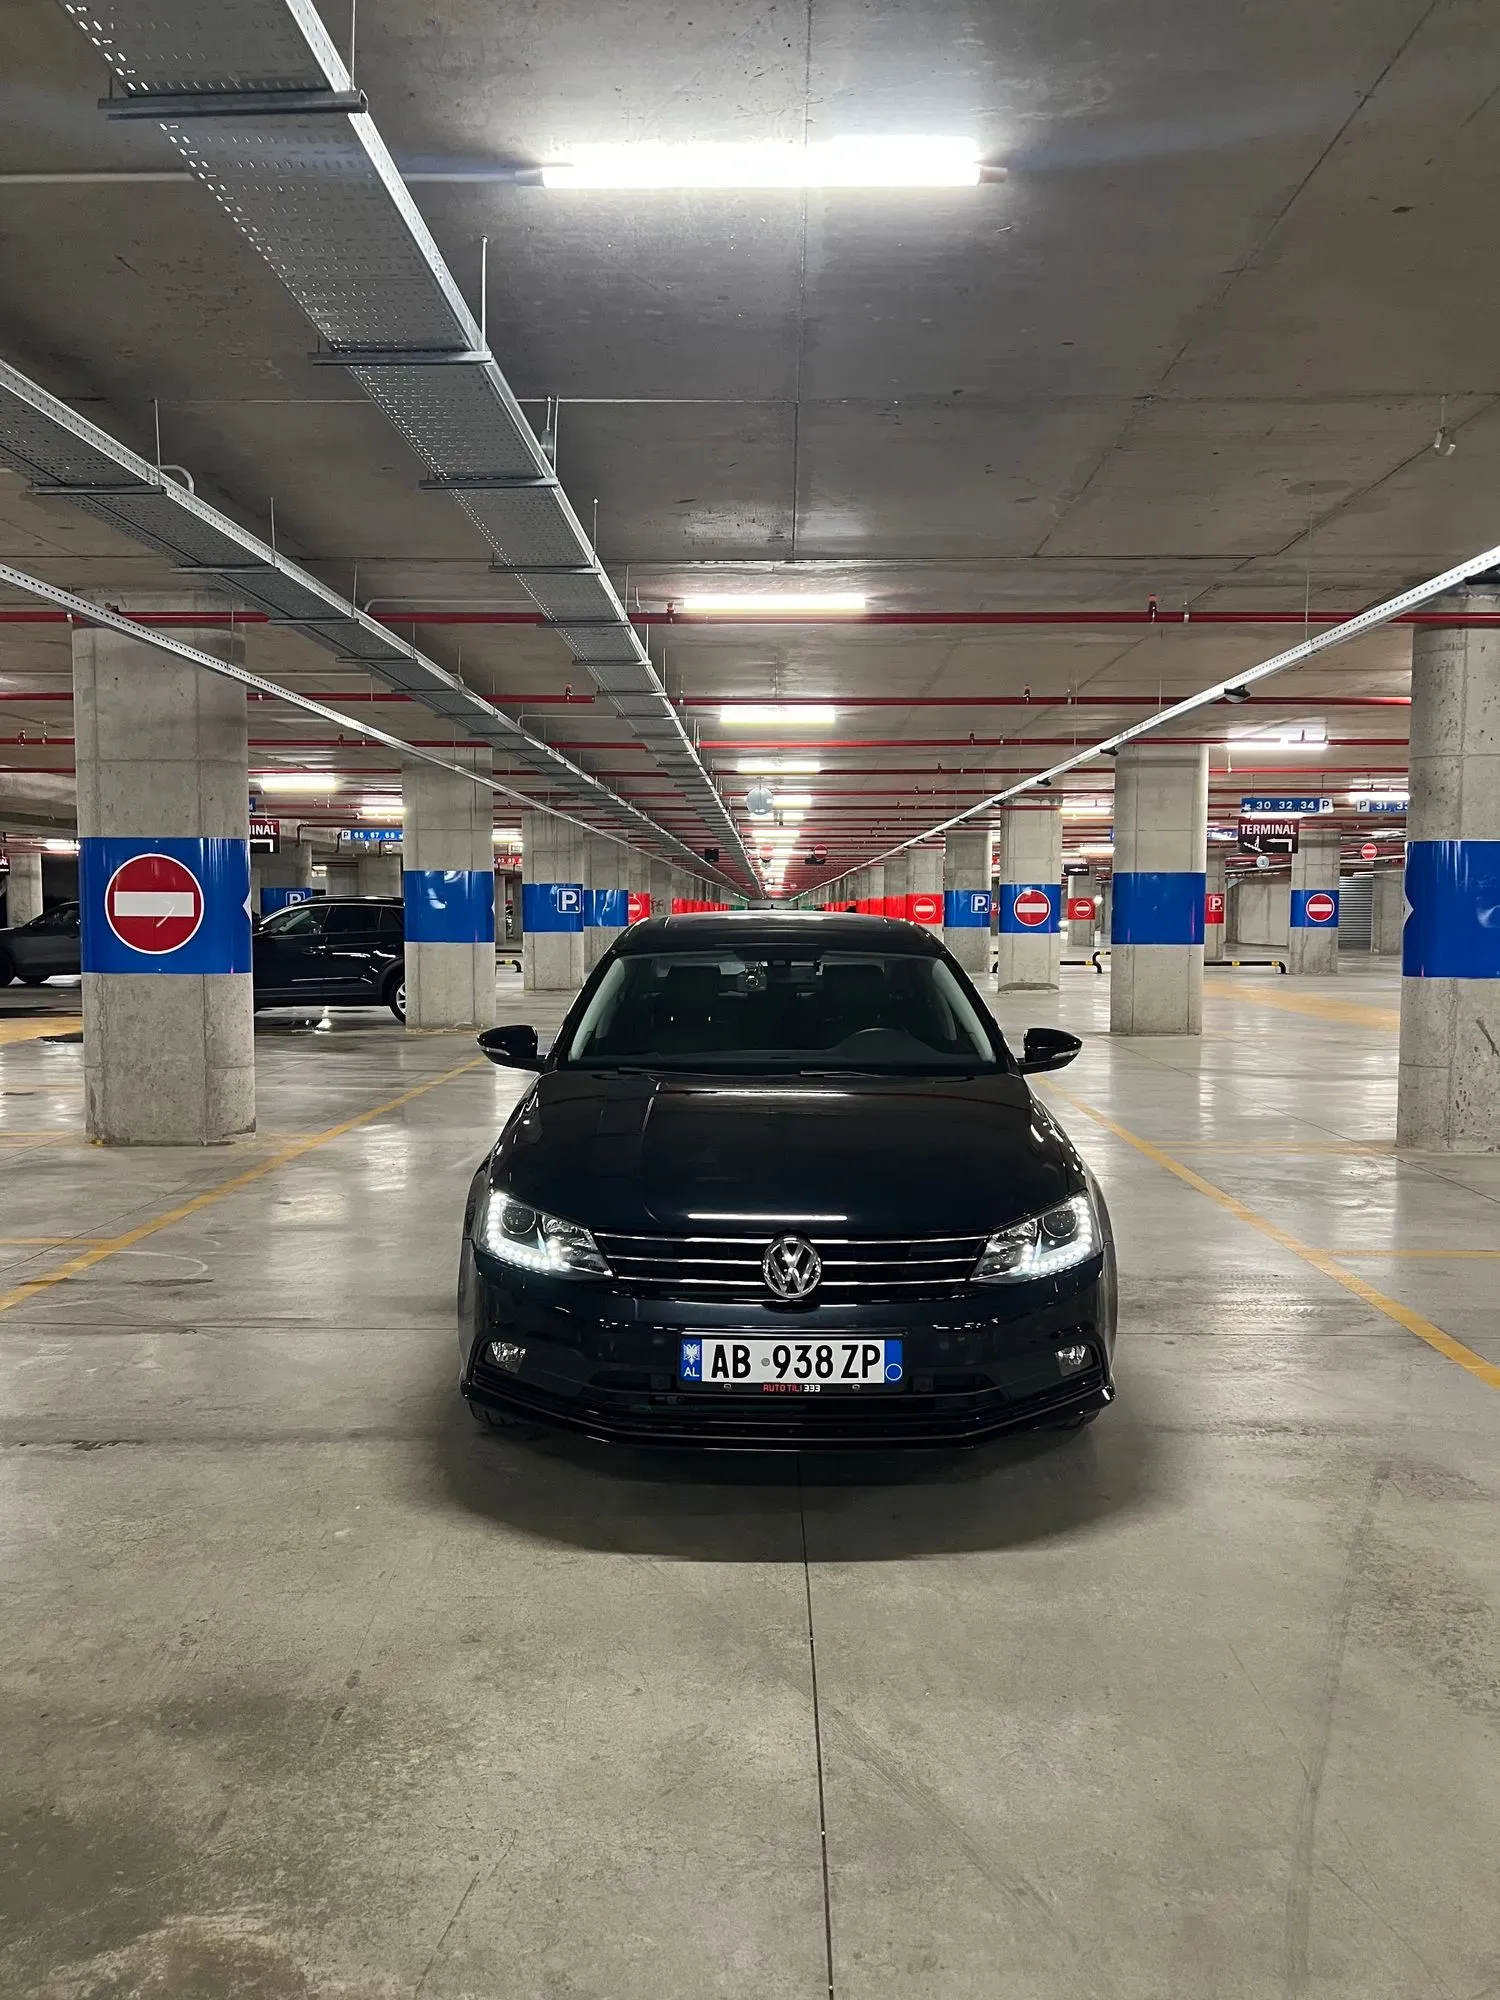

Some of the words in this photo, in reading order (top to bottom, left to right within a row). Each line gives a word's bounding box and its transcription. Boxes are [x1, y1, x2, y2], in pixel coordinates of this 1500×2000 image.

[1256, 801, 1271, 809] 30
[1279, 801, 1293, 809] 32
[1300, 801, 1315, 809] 34
[1322, 800, 1330, 810] P
[1360, 801, 1367, 810] P
[1376, 802, 1387, 810] 31
[249, 824, 277, 835] INAL
[1240, 824, 1297, 835] TERMINAL
[562, 891, 577, 911] P
[974, 896, 986, 911] P
[1211, 897, 1222, 910] P
[711, 1344, 751, 1379] AB
[772, 1344, 834, 1379] 938
[840, 1344, 881, 1379] ZP
[684, 1366, 700, 1377] AL
[763, 1384, 786, 1392] AUTO
[803, 1384, 821, 1392] 333
